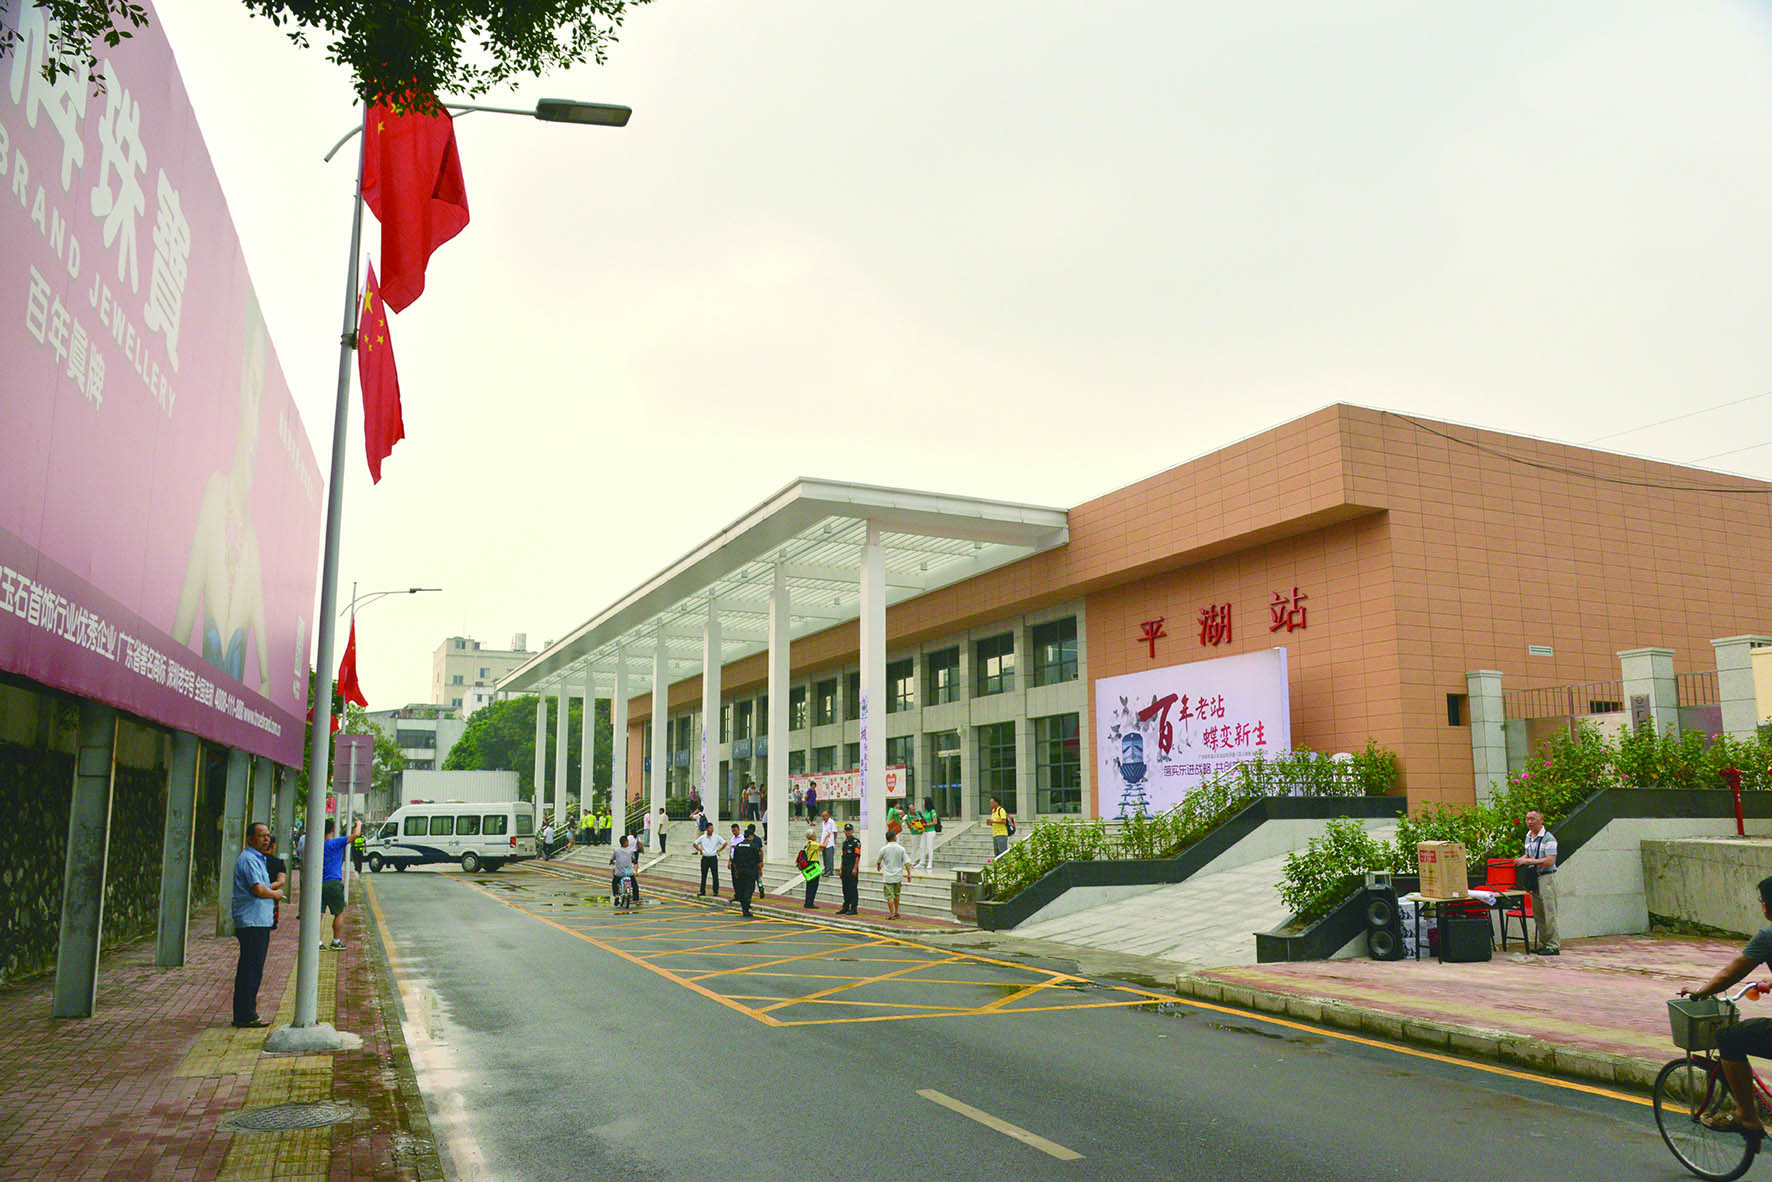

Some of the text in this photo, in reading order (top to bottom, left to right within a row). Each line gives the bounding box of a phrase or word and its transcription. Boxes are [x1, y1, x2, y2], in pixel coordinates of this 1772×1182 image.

[88, 273, 176, 418] JEWELLERY
[0, 565, 117, 660] 玉石首饰行业优秀企业
[1136, 586, 1308, 658] 平湖站
[1138, 693, 1226, 755] 百年老站
[1202, 720, 1267, 750] 蝶变新生
